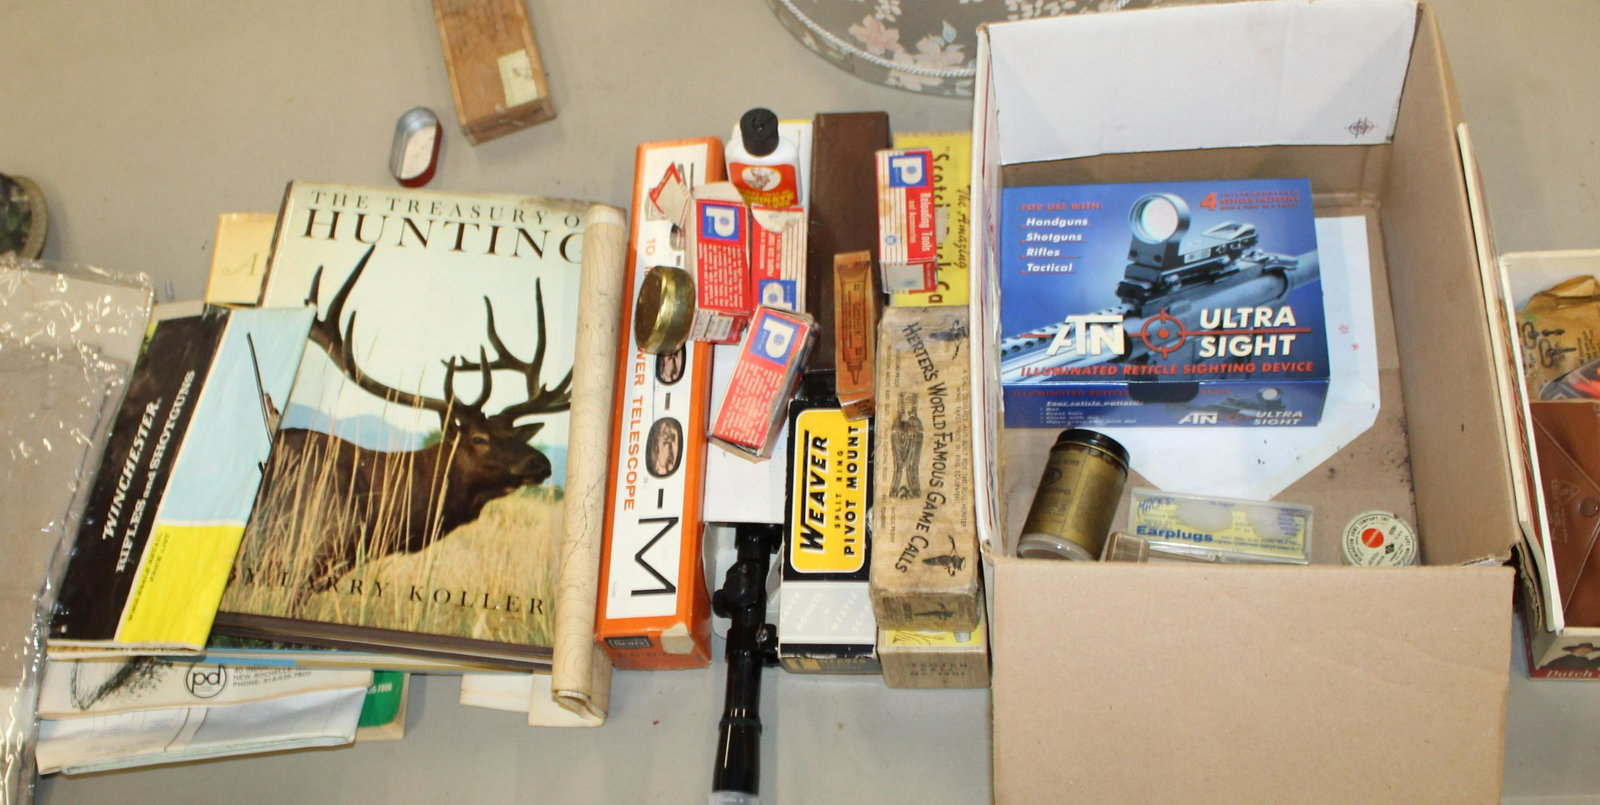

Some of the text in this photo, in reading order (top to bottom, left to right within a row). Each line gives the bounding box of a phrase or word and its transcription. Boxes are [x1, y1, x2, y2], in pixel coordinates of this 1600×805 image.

[310, 190, 581, 229] THE TREASURY O
[919, 193, 932, 229] Reloading
[1020, 203, 1043, 211] FOR
[1045, 203, 1067, 211] USE
[1200, 192, 1217, 211] 4
[1026, 217, 1088, 228] Handguns
[922, 230, 933, 253] Tools
[953, 211, 969, 269] Amazing
[1026, 232, 1082, 244] Shotguns
[1026, 247, 1060, 257] Rifles
[1027, 262, 1073, 272] Tactical
[1199, 306, 1297, 329] ULTRA
[1045, 314, 1125, 357] ATN
[1199, 335, 1297, 358] SIGHT
[1020, 362, 1314, 377] ILLUMINATED RETICLE SIGHTING DEVICE
[927, 382, 948, 430] WORLD
[1178, 412, 1218, 425] ATN
[1256, 410, 1303, 418] ULTRA
[1253, 418, 1301, 426] SIGHT
[624, 396, 643, 511] TELESCOPE
[929, 432, 953, 489] FAMOUS
[116, 498, 146, 574] RIFLES
[149, 369, 196, 471] SHOTGUNS
[800, 430, 828, 552] WEAVER
[834, 450, 844, 528] SPLIT RING
[844, 426, 859, 556] PIVOT MOUNT
[916, 491, 947, 533] GAME
[1136, 525, 1213, 543] Earplugs
[895, 535, 929, 574] CALLS
[281, 567, 391, 598] LARRY
[409, 586, 545, 616] KOLLER
